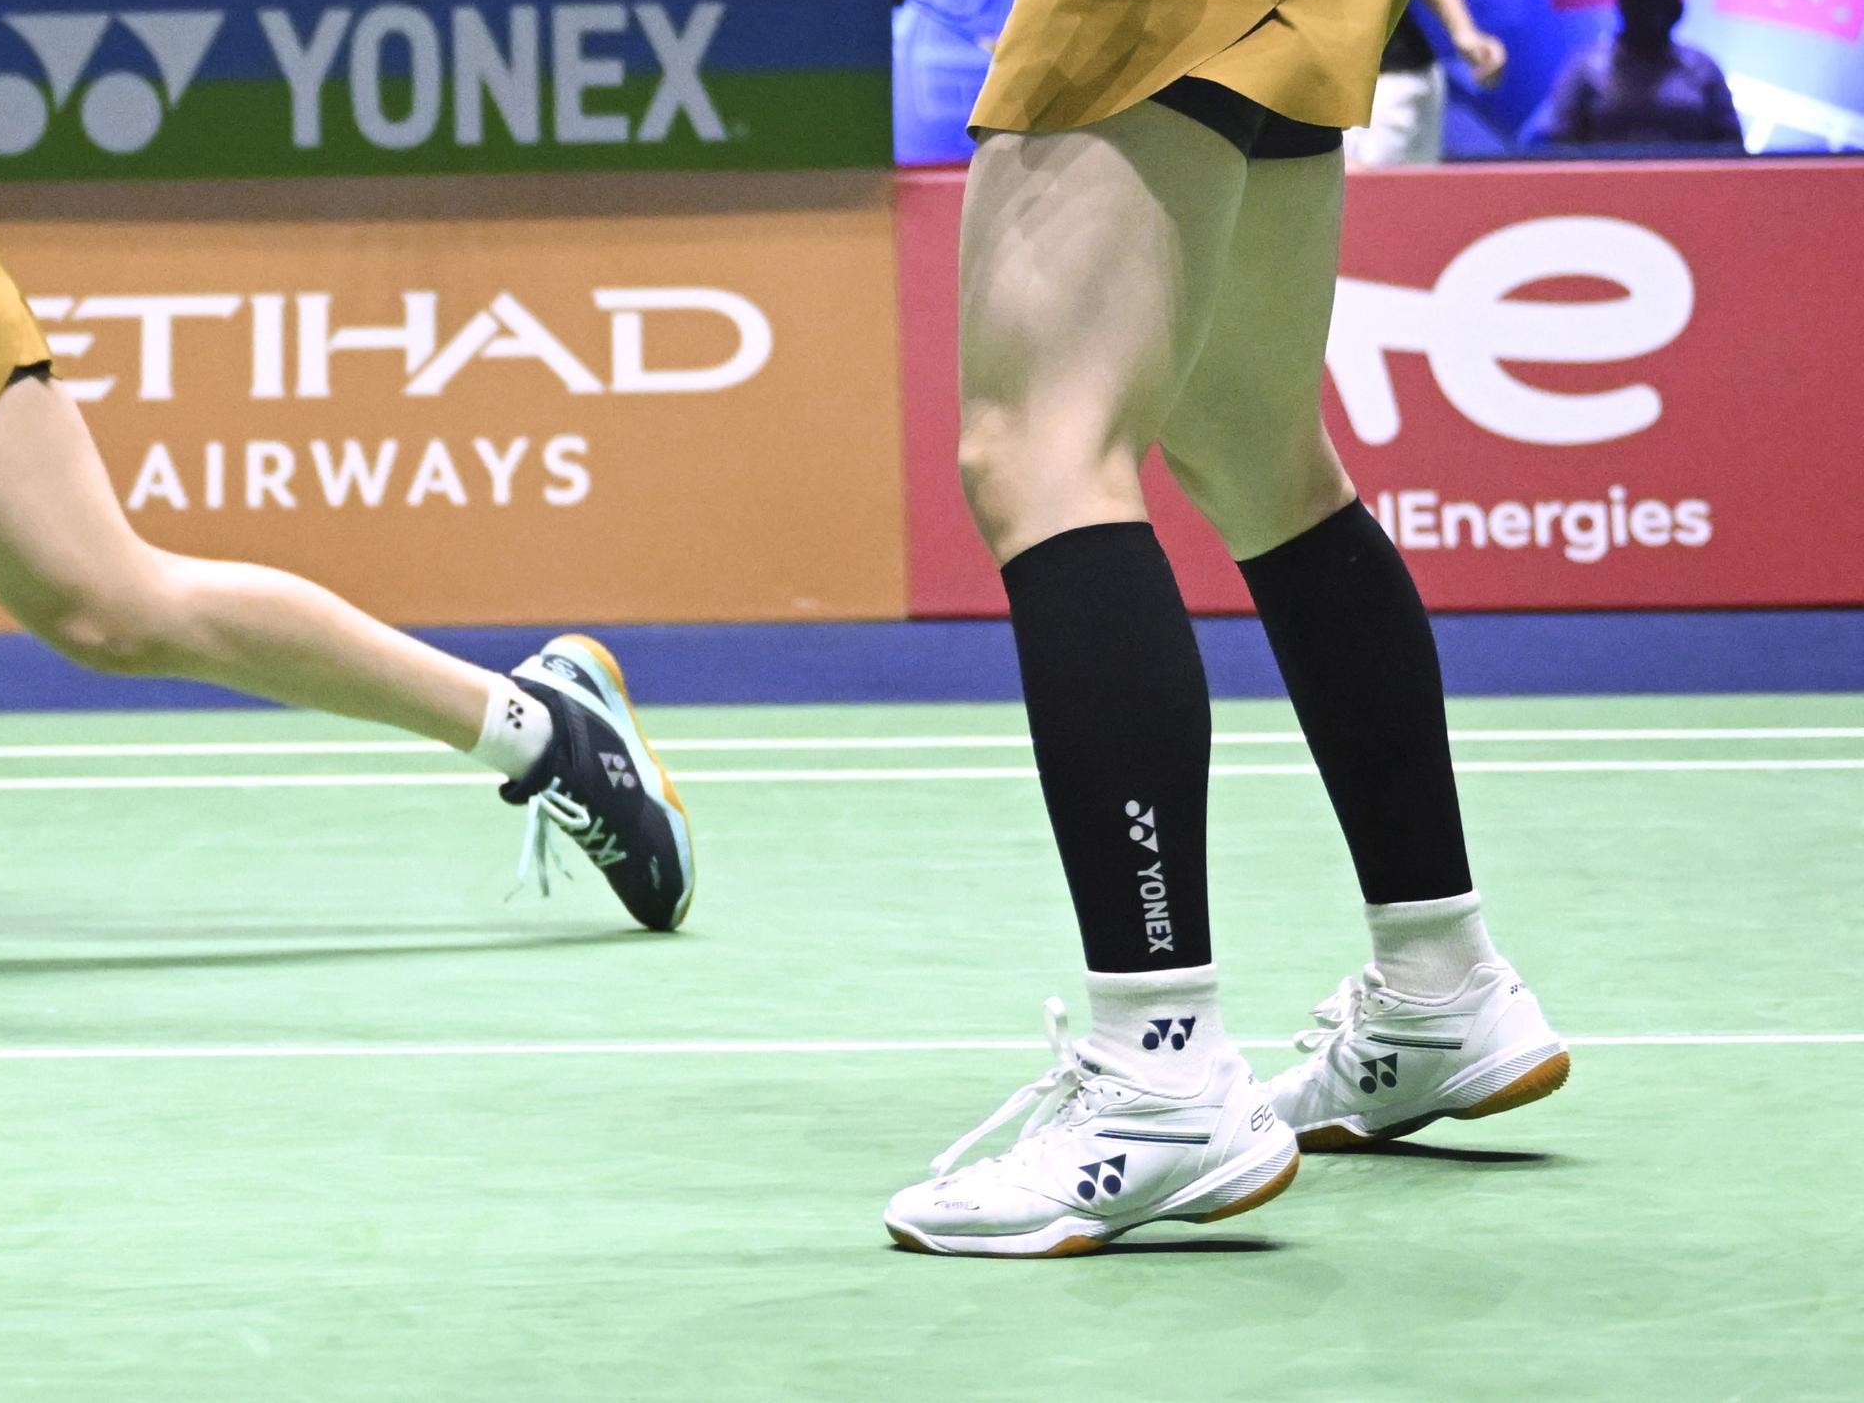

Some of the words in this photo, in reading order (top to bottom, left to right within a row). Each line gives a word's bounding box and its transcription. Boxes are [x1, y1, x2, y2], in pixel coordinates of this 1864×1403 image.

[256, 1, 728, 150] YONEX
[26, 287, 774, 402] ETIHAD
[127, 433, 591, 510] AIRWAYS
[1137, 860, 1174, 953] YONEX
